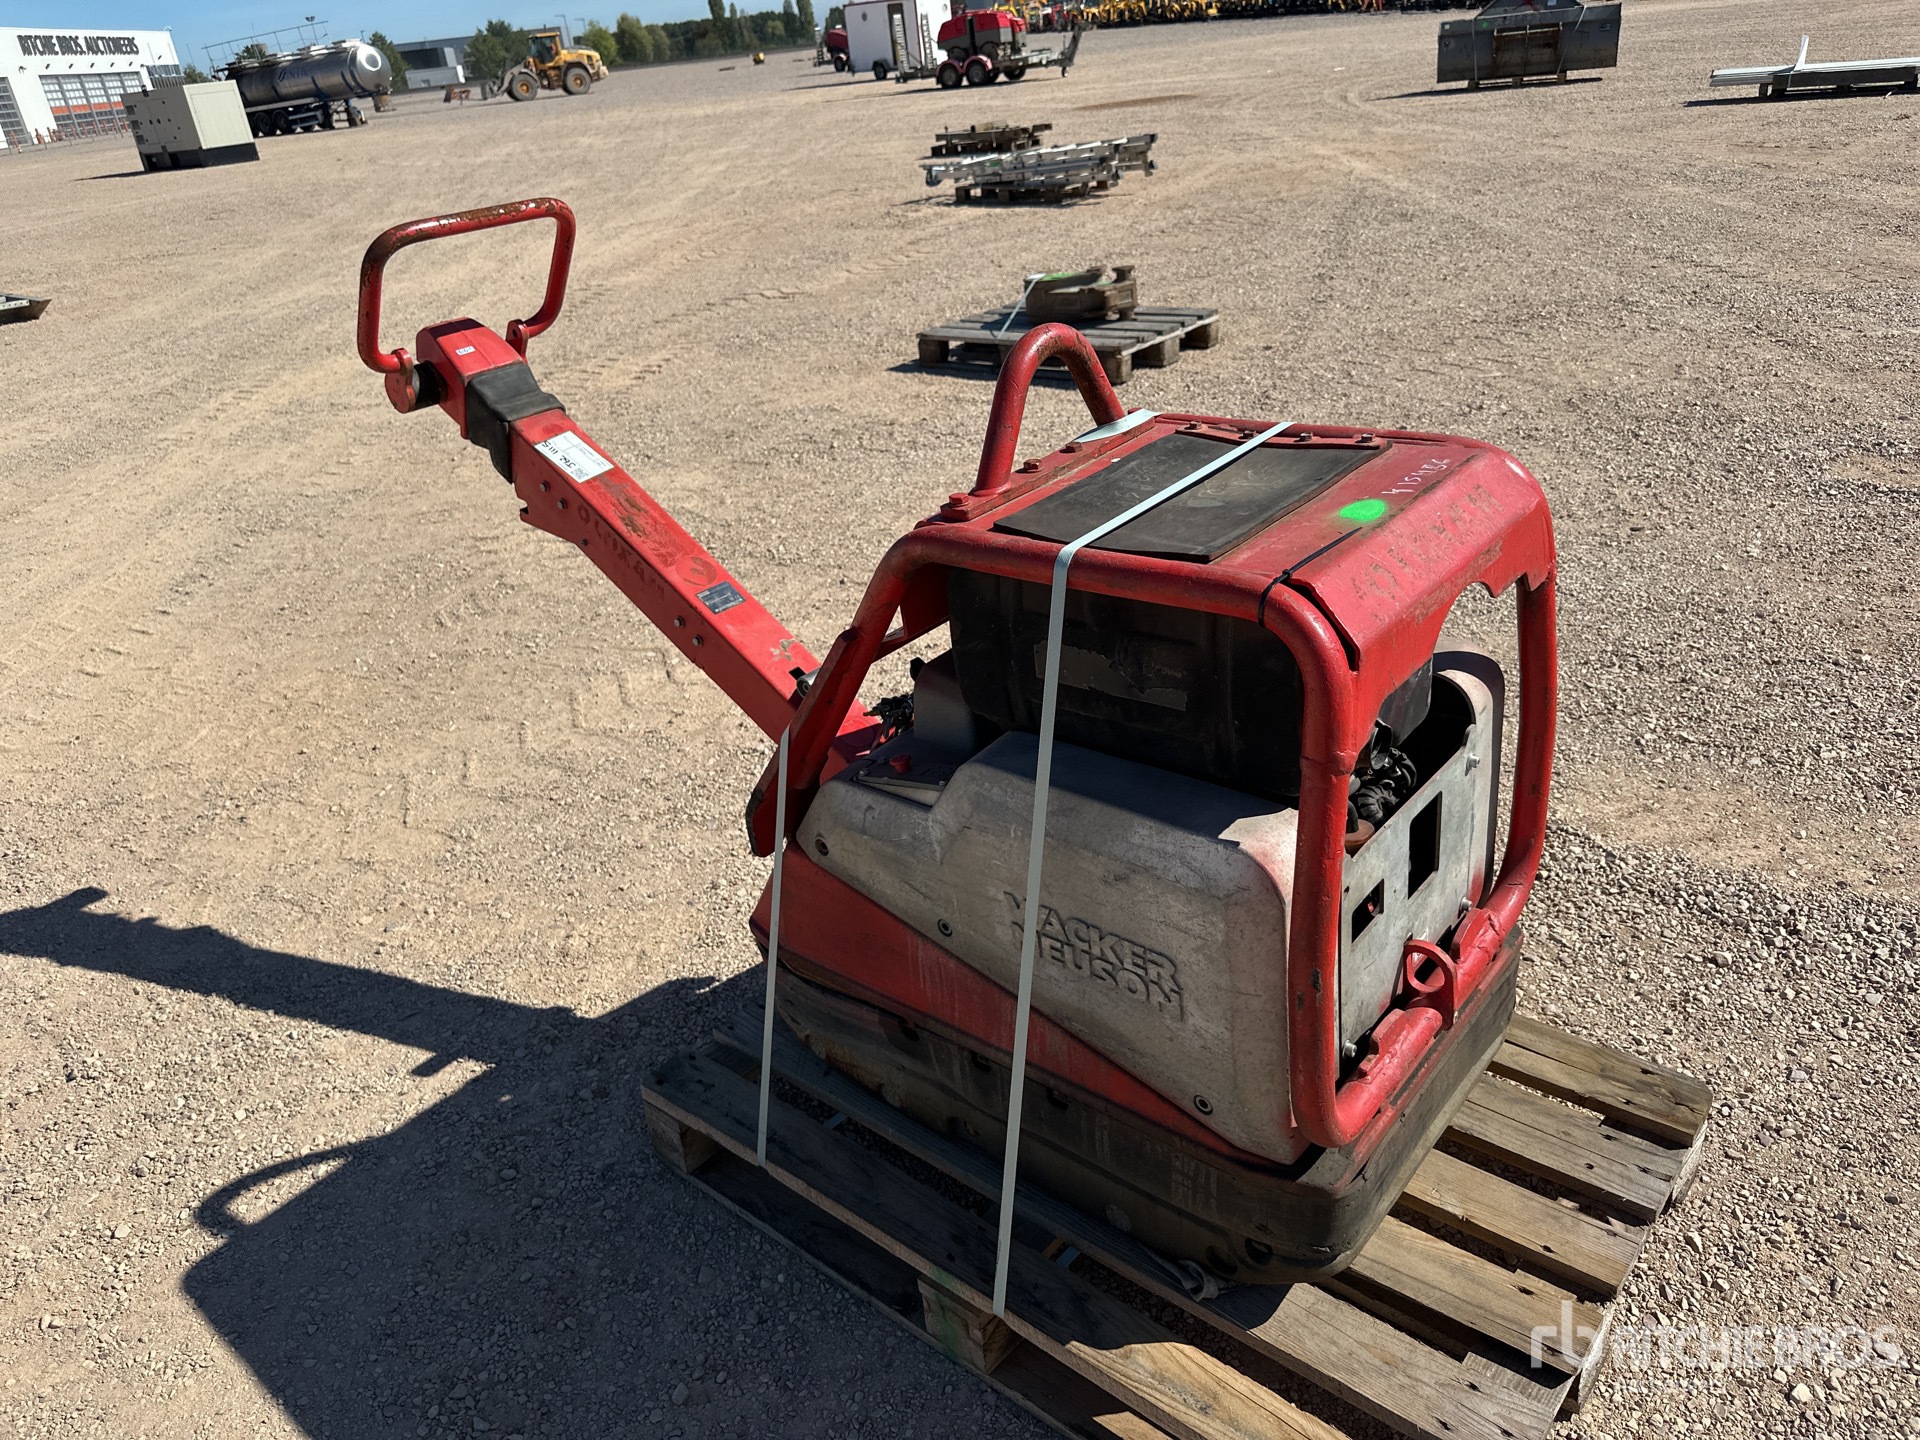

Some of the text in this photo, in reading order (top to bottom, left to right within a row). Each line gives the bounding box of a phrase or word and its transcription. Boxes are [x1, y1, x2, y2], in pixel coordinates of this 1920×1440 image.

[17, 34, 139, 56] RITCHIE BROS. AUCTIONEERS
[1003, 891, 1184, 994] WACKER
